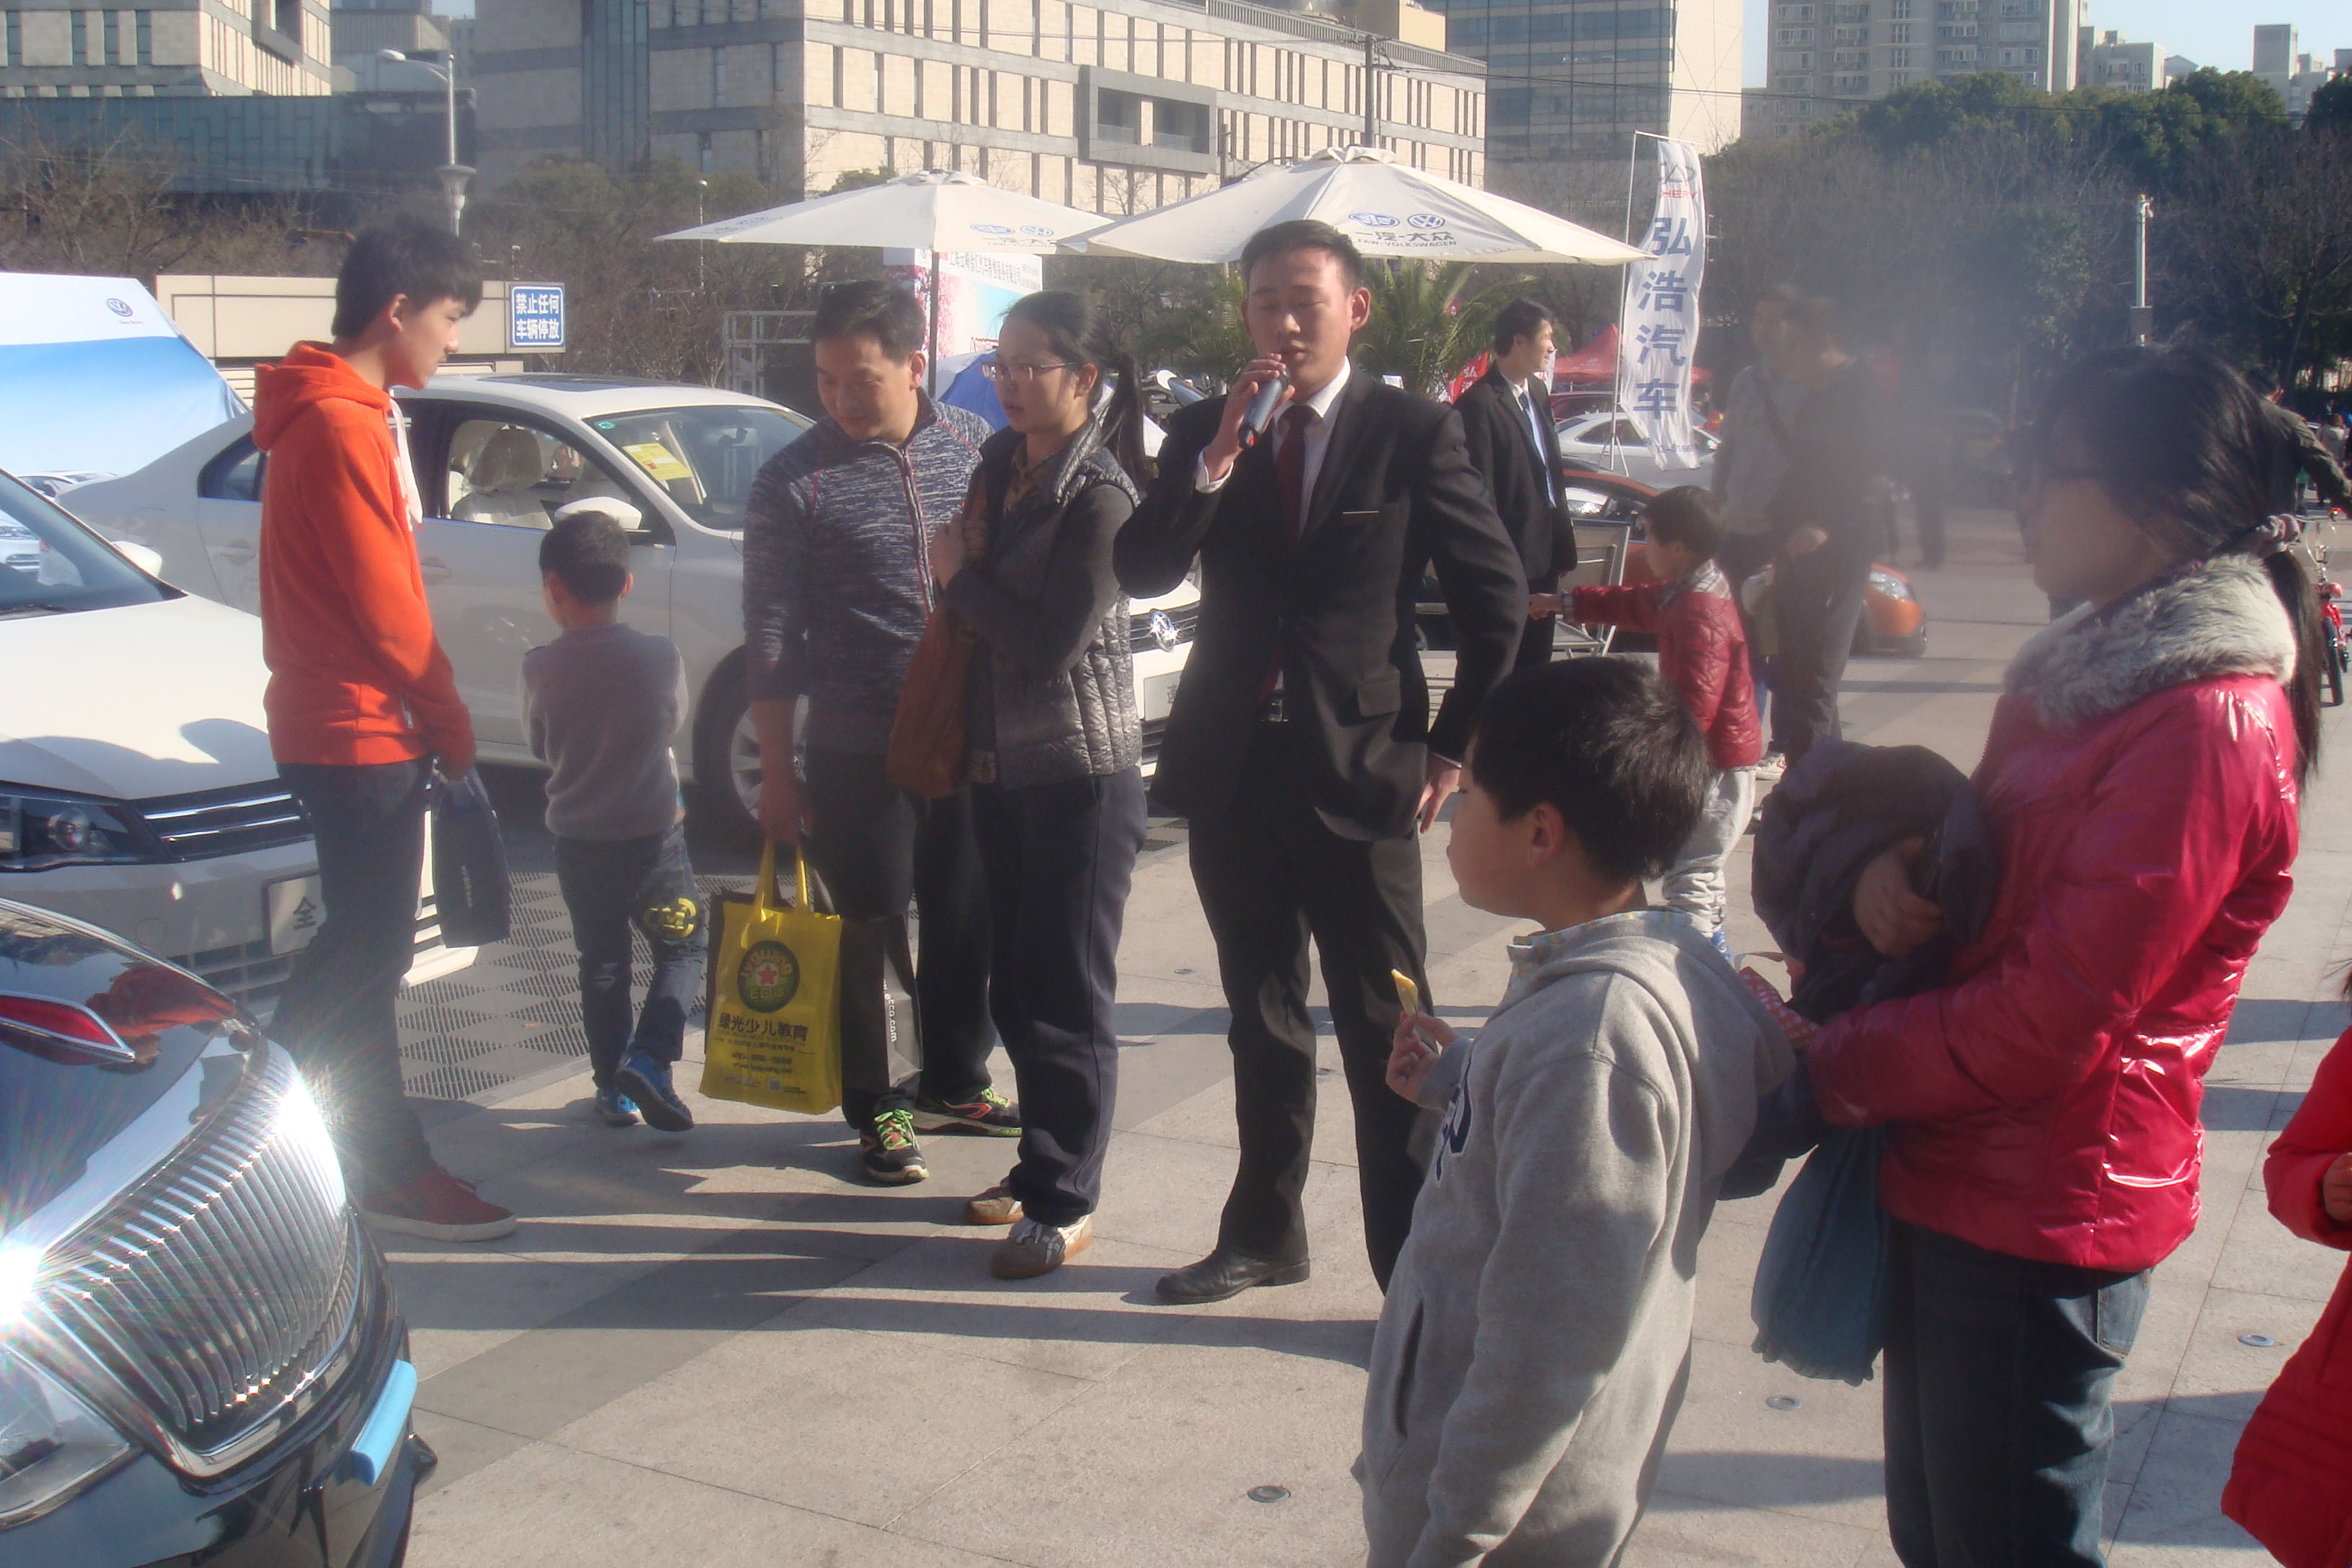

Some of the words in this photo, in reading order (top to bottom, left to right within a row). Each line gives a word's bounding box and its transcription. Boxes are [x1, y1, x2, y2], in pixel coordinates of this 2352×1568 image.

[515, 293, 559, 315] 禁止任何
[515, 318, 560, 339] 车辆停放
[1633, 218, 1691, 419] 弘浩汽车
